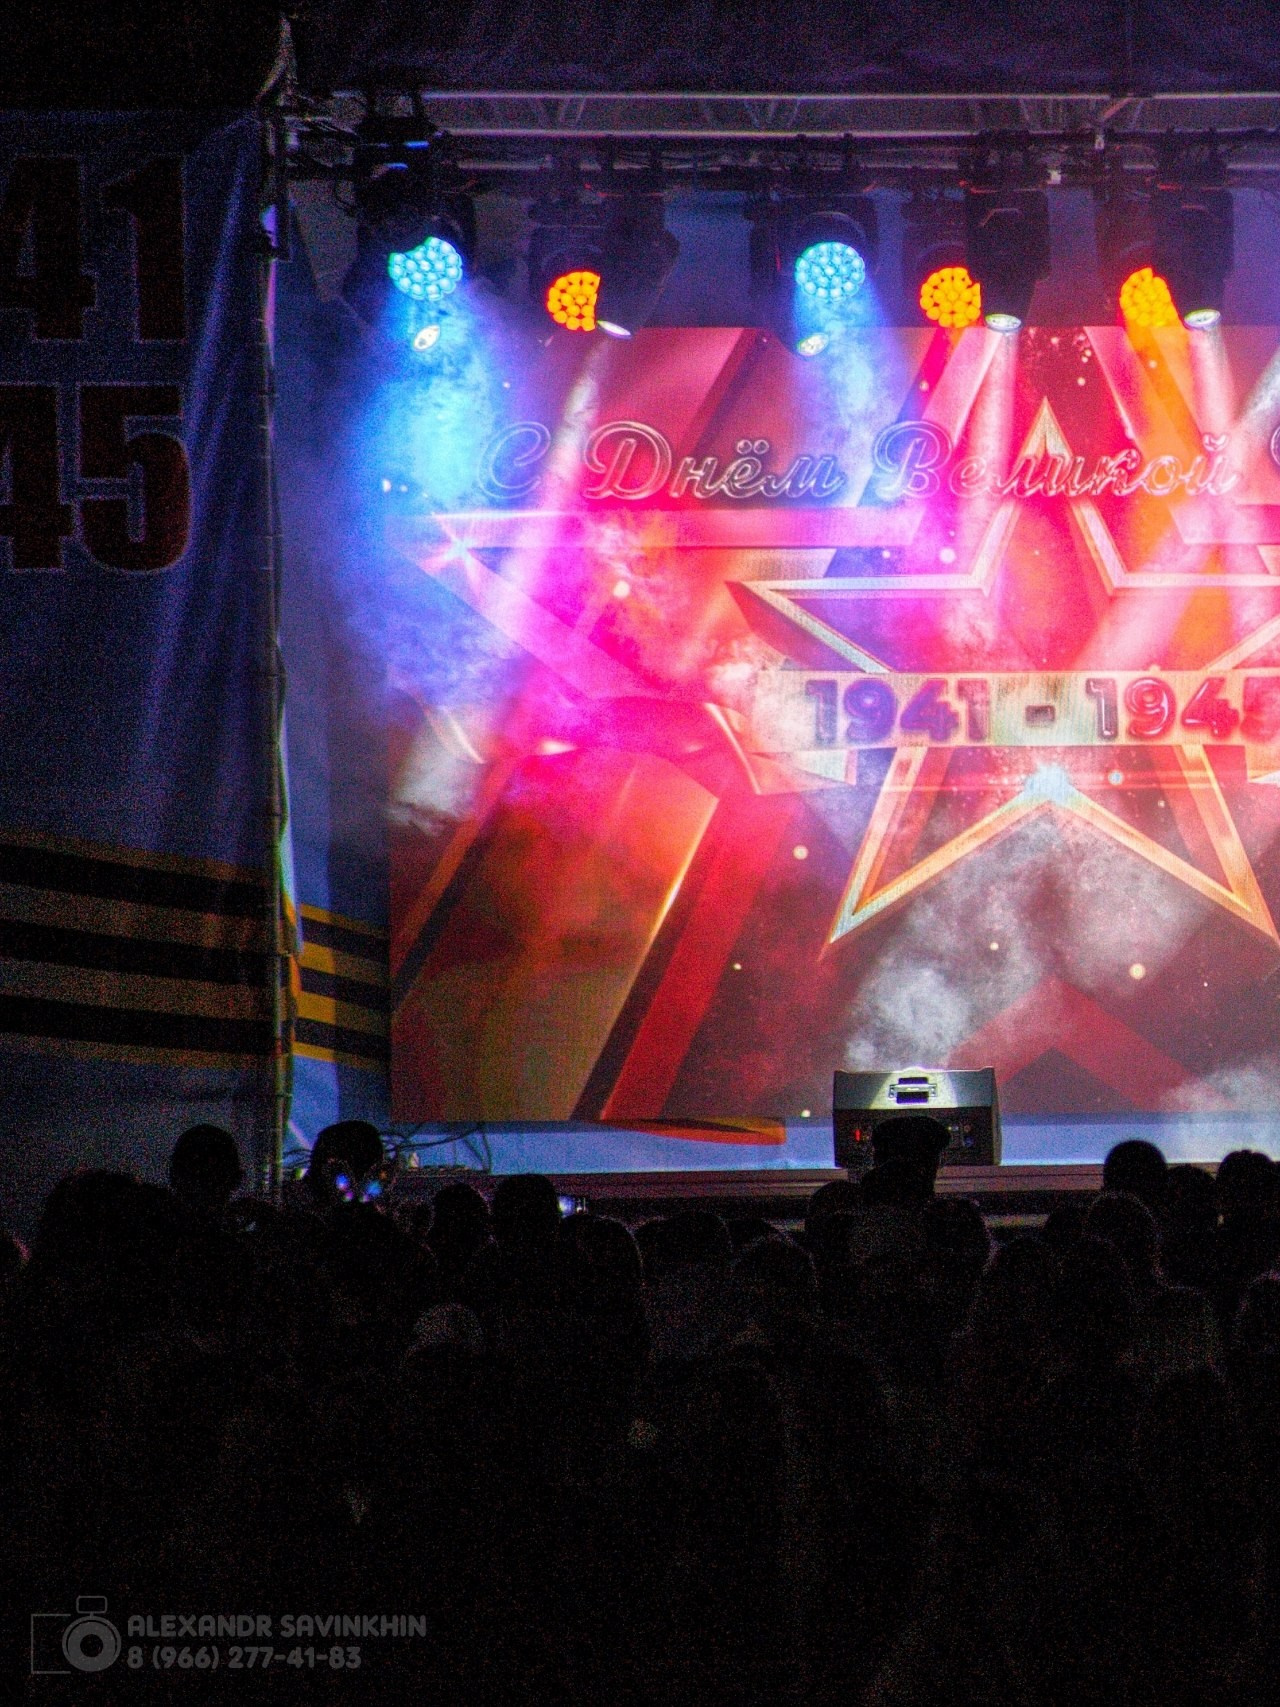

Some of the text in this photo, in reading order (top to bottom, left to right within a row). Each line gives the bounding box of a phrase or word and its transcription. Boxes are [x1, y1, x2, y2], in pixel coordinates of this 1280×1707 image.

[477, 420, 552, 499] С
[582, 420, 847, 500] Днём
[873, 419, 1238, 499] Великой
[804, 677, 991, 744] 1941
